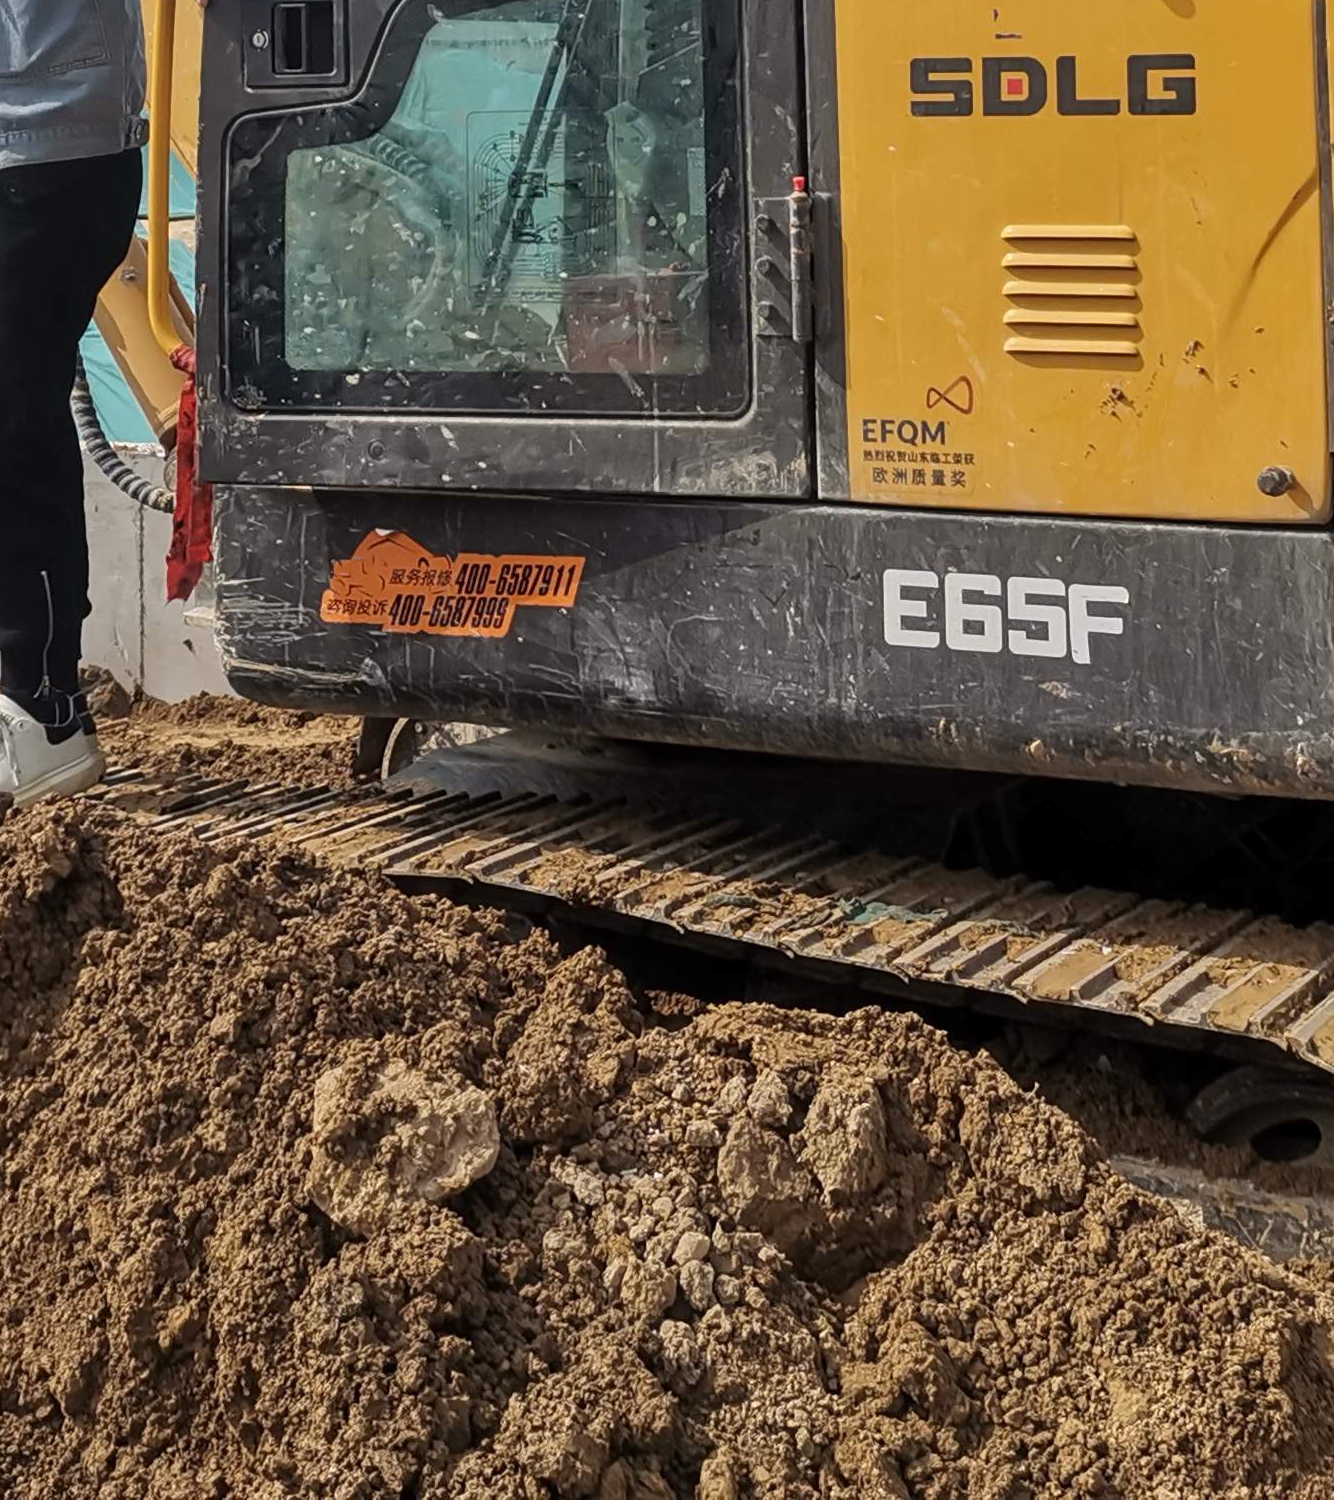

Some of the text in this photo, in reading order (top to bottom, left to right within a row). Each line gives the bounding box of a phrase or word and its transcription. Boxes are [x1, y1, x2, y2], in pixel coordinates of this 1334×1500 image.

[910, 53, 1197, 118] SDLG
[862, 418, 946, 447] EFQM
[872, 466, 967, 488] 欧洲质量奖
[388, 563, 577, 597] 服务报修 400-6587911
[327, 594, 510, 629] 咨询投诉 400-6587999
[883, 568, 1130, 665] E65F
